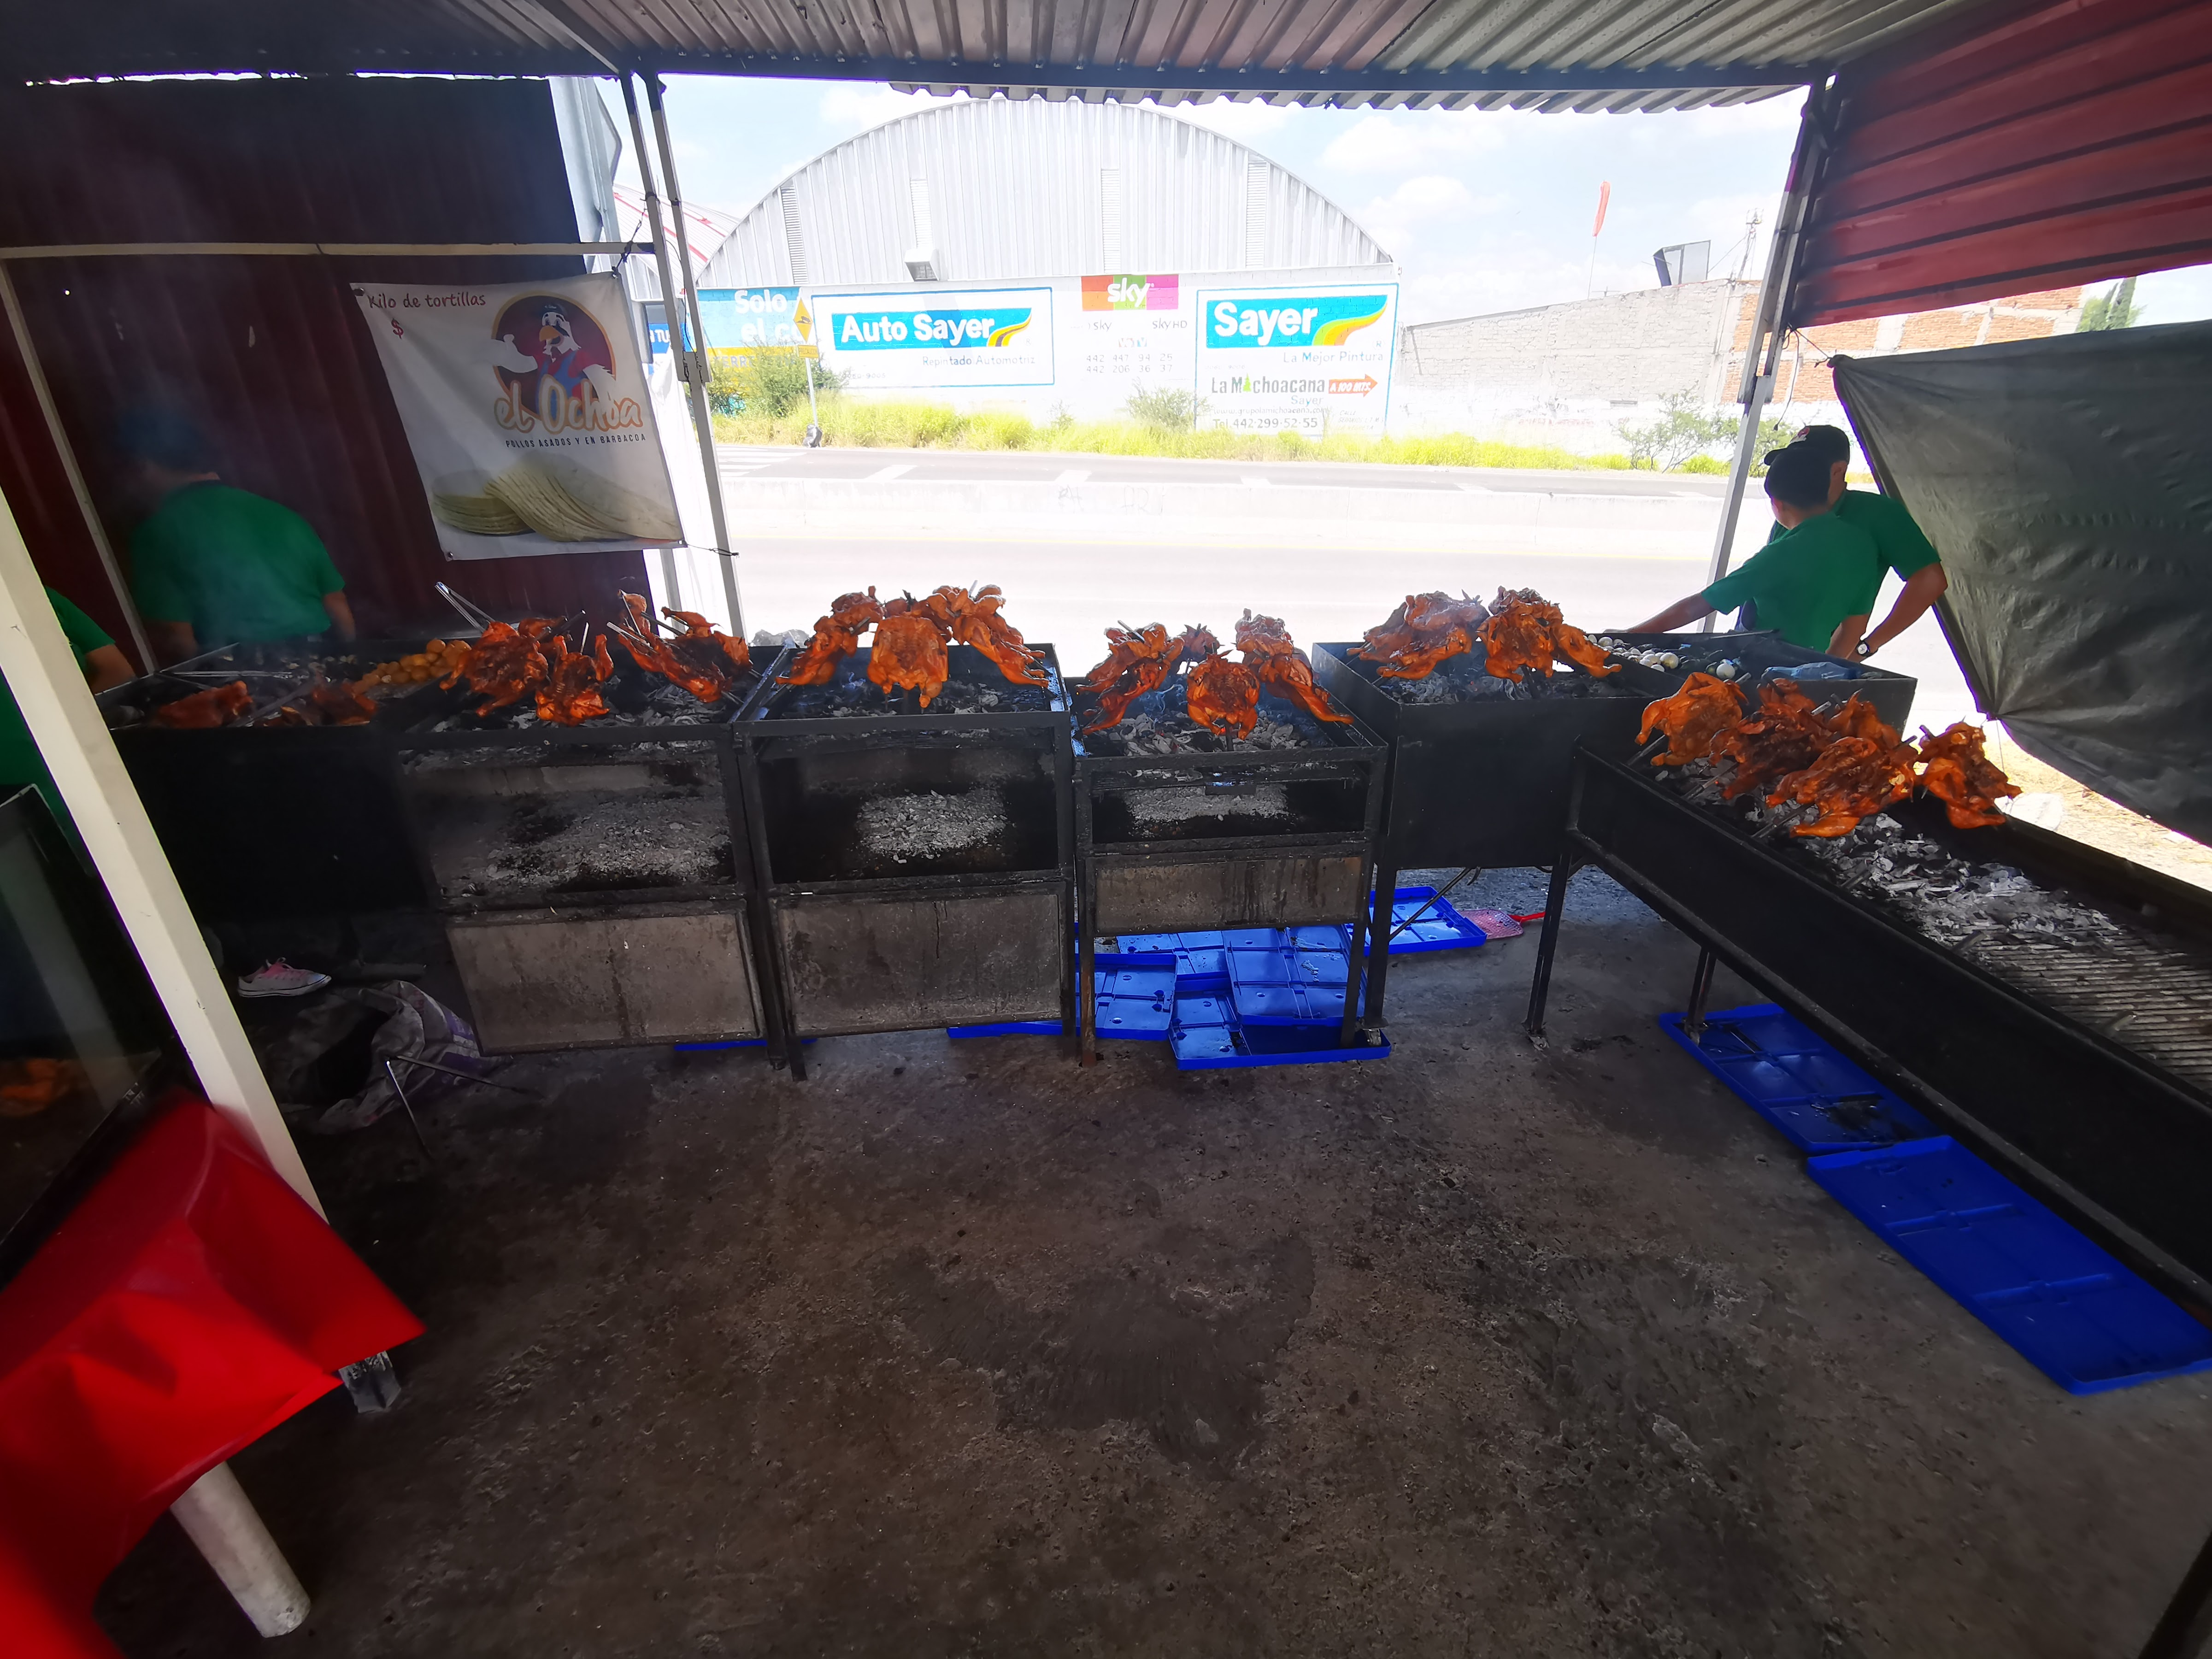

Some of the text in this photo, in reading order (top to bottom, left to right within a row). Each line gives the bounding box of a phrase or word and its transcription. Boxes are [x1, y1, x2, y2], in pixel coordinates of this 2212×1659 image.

[404, 294, 420, 307] de
[425, 292, 486, 307] tortillas
[1107, 277, 1151, 307] sky
[735, 289, 788, 314] Solo
[740, 318, 767, 342] el
[841, 314, 995, 347] Auto Sayer
[1172, 320, 1188, 329] HD
[1214, 301, 1318, 346] Sayer
[923, 355, 1035, 369] Repintado Automotriz
[1159, 353, 1172, 361] 25
[1283, 350, 1383, 366] La Mejor Pintura
[1112, 365, 1130, 373] 206
[1160, 364, 1172, 372] 37
[1212, 372, 1325, 394] La Michoacana
[1330, 382, 1336, 392] A
[1337, 382, 1353, 392] 100
[1291, 394, 1324, 407] Sayer
[506, 439, 535, 448] POLLOS
[539, 438, 571, 447] ASADOS
[600, 434, 646, 444] BARBACOA
